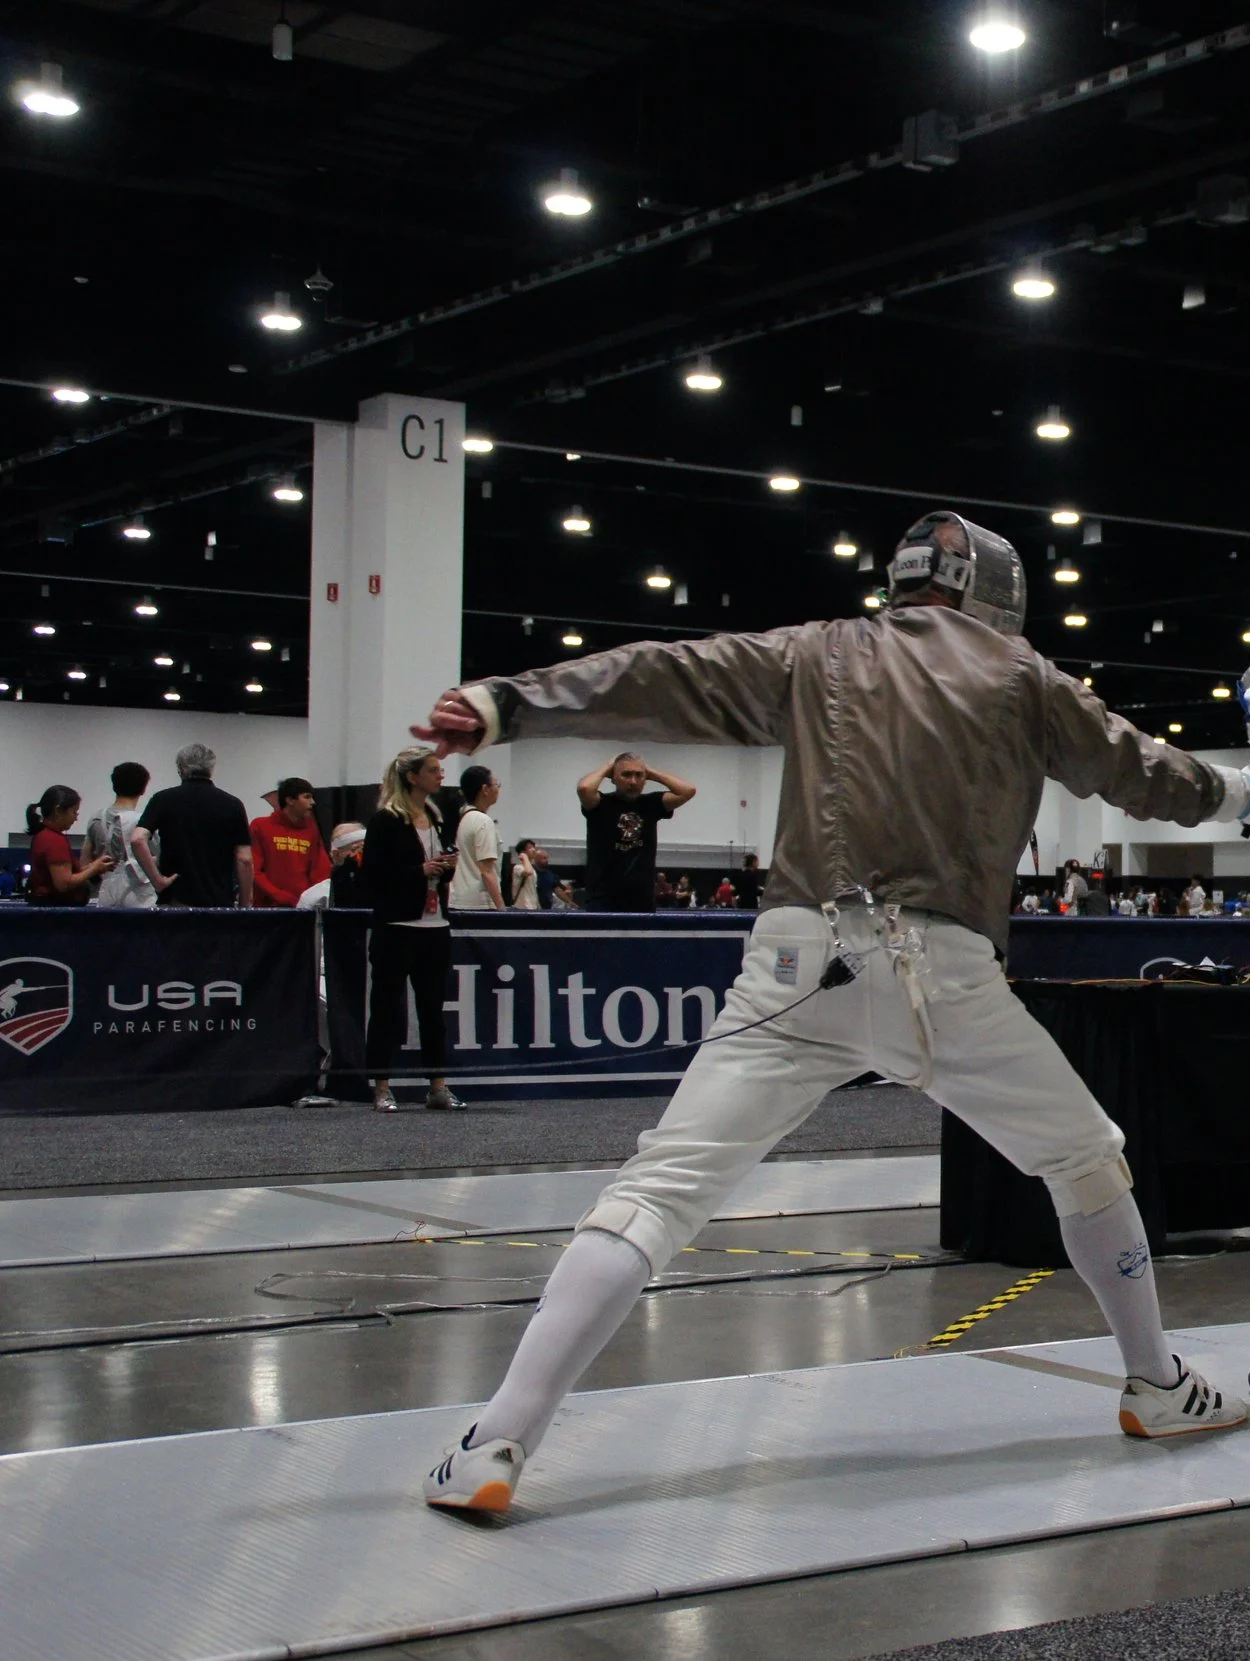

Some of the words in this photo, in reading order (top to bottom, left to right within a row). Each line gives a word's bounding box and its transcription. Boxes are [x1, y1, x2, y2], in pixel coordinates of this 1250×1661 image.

[401, 414, 448, 463] C1
[108, 980, 242, 1012] USA
[401, 964, 716, 1050] Hilton
[93, 1018, 257, 1034] PARAFENCING
